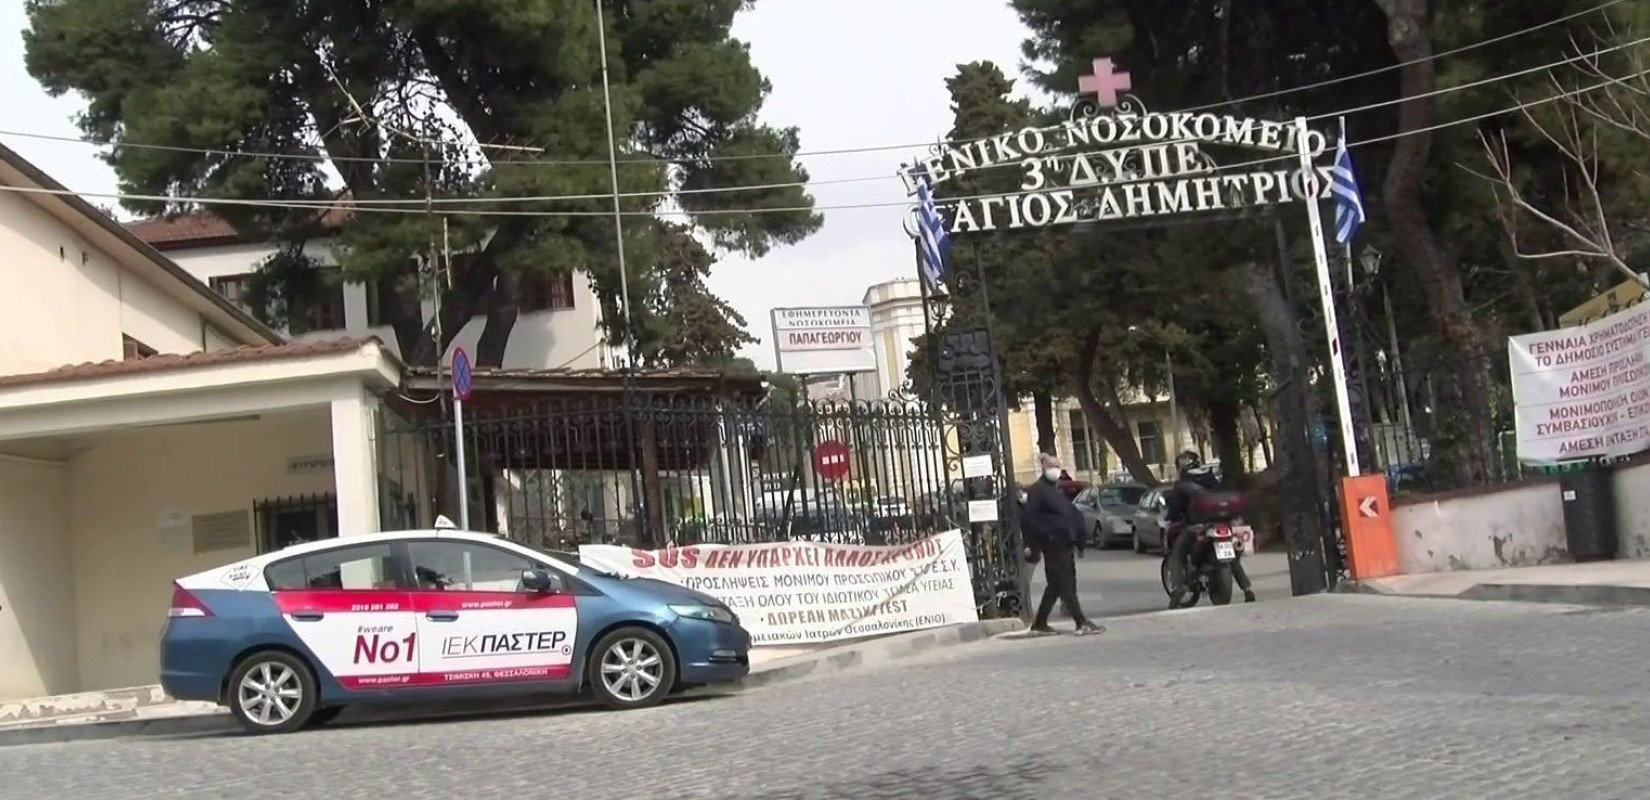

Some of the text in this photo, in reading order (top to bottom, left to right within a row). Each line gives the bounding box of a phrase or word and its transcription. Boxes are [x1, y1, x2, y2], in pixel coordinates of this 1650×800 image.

[898, 111, 1326, 195] ΓΕΝΙΚΟ ΝΟΣΟΚΟΜΕΙΟ
[951, 190, 1078, 233] ΑΓΙΟΣ
[1098, 166, 1333, 220] ΔΗΜΗΤΡΙΟΣ
[782, 309, 861, 319] ΕΦΗΜΕΡΕΥΟΝΤΑ
[788, 319, 856, 327] ΝΟΣΟΚΟΜΕΙΑ
[789, 331, 862, 345] ΠΑΠΑΓΕΩΡΓΙΟΥ
[1529, 335, 1587, 355] ΓΕΝΝΑΙΑ
[1536, 354, 1552, 367] ΤΟ
[1556, 344, 1604, 365] ΔΗΜΟΣΙΟ
[1571, 365, 1607, 382] ΑΜΕΣΗ
[1559, 379, 1611, 398] ΜΟΝΙΜΟΥ
[1559, 435, 1604, 453] ΑΜΕΣΗ
[632, 546, 700, 568] SOS
[705, 548, 744, 568] ΔΕΝ
[747, 546, 820, 568] ΥΠΑΡΧΕΙ
[774, 573, 830, 587] ΜΟΝΙΜΟΥ
[834, 567, 906, 585] ΠΡΟΣΩΠΙΚΟΥ
[758, 593, 792, 608] ΟΛΟΥ
[796, 592, 819, 605] ΤΟΥ
[822, 589, 880, 605] ΙΔΙΩΤΙΚΟΥ
[921, 578, 955, 592] ΥΓΕΙΑΣ
[767, 610, 826, 626] ΔΩΡΕΑΝ
[357, 625, 394, 633] #weare
[752, 629, 802, 643] μειακών
[805, 625, 842, 640] Ιατρών
[845, 616, 914, 635] Θεσσαλονίκης
[353, 632, 416, 664] No1
[494, 668, 548, 679] ΘΕΣΣΑΛΟΝΙΚΗ
